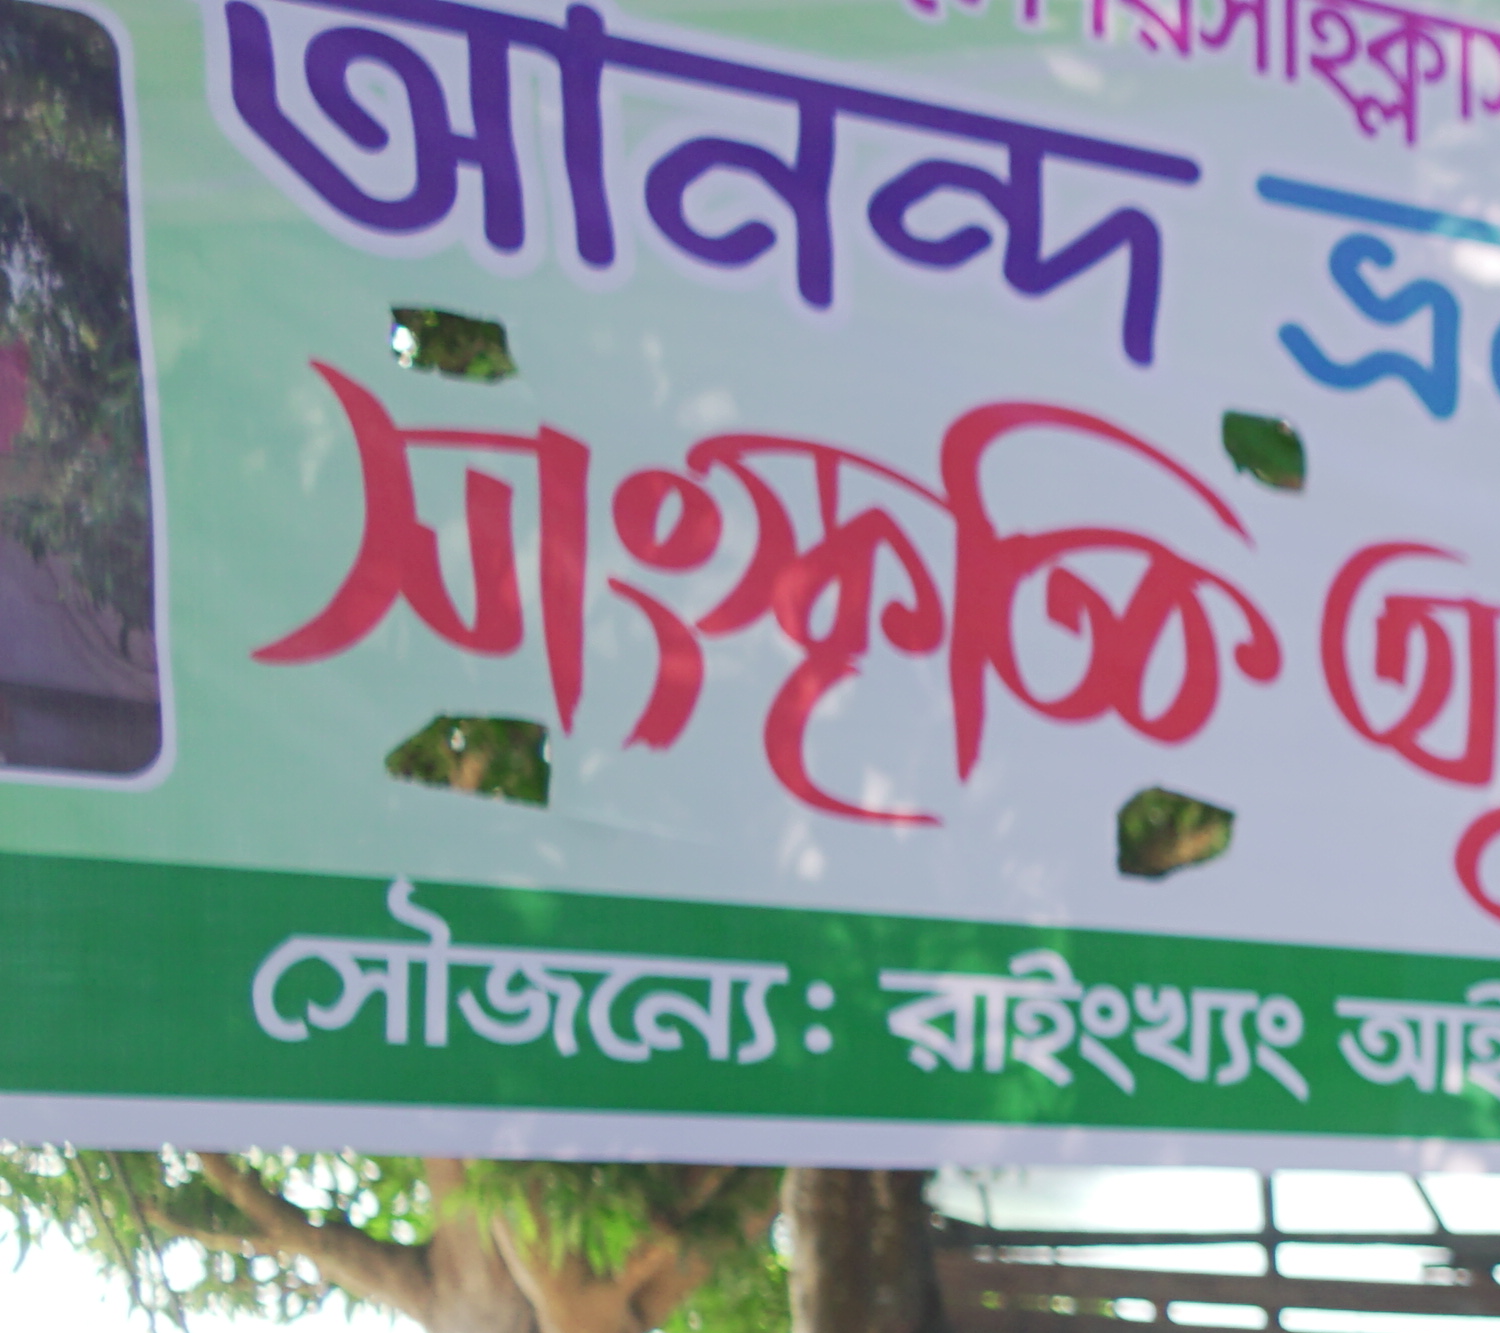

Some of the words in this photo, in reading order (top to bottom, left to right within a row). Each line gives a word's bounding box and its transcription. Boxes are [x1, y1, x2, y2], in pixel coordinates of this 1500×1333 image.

[224, 0, 1201, 366] আনন্দ
[252, 358, 1282, 825] সাংস্কৃতিক
[878, 949, 1310, 1101] রাইংখ্যং
